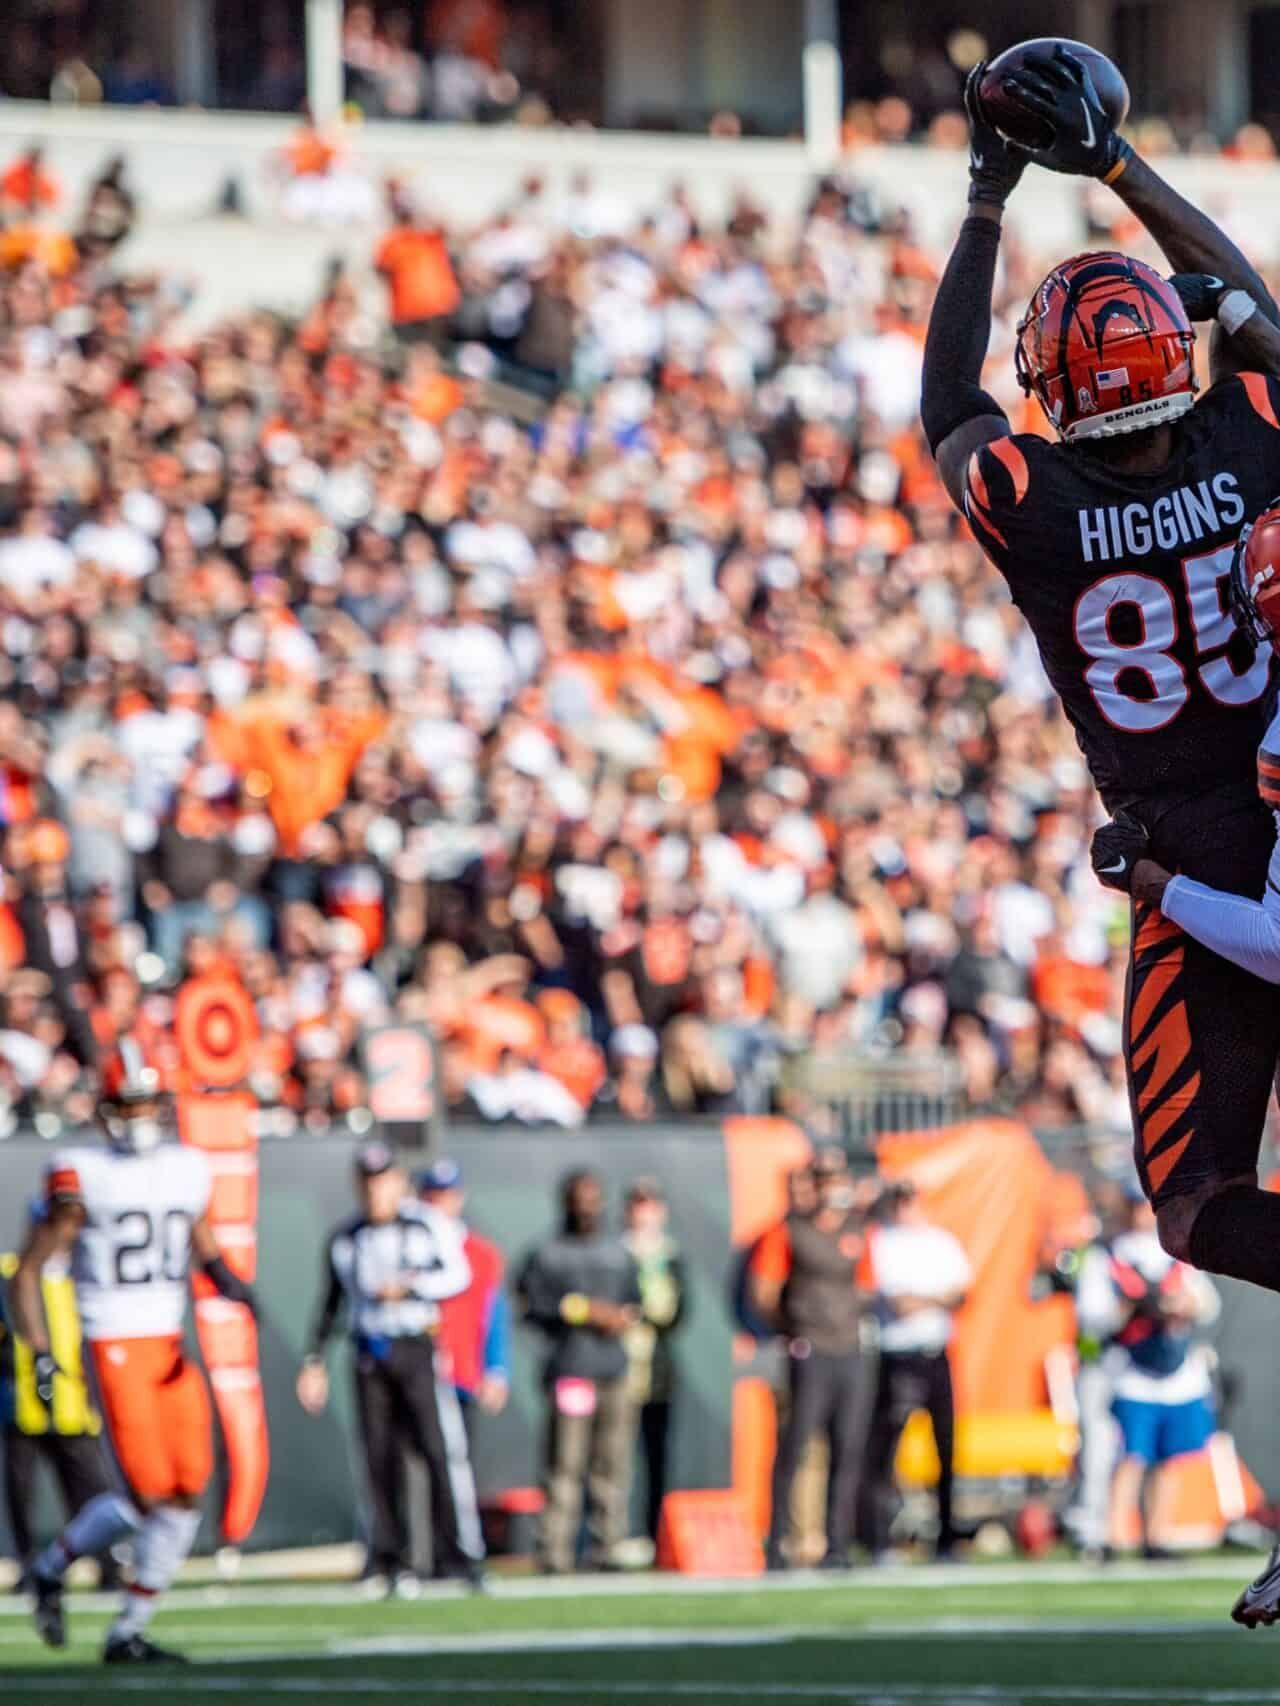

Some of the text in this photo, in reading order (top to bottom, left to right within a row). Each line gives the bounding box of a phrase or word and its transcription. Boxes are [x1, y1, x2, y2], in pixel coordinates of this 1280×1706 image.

[1104, 400, 1169, 422] BENGALS
[1078, 472, 1245, 562] HIGGINS
[1073, 541, 1273, 733] 85
[367, 1028, 433, 1121] 2
[114, 1208, 193, 1285] 20
